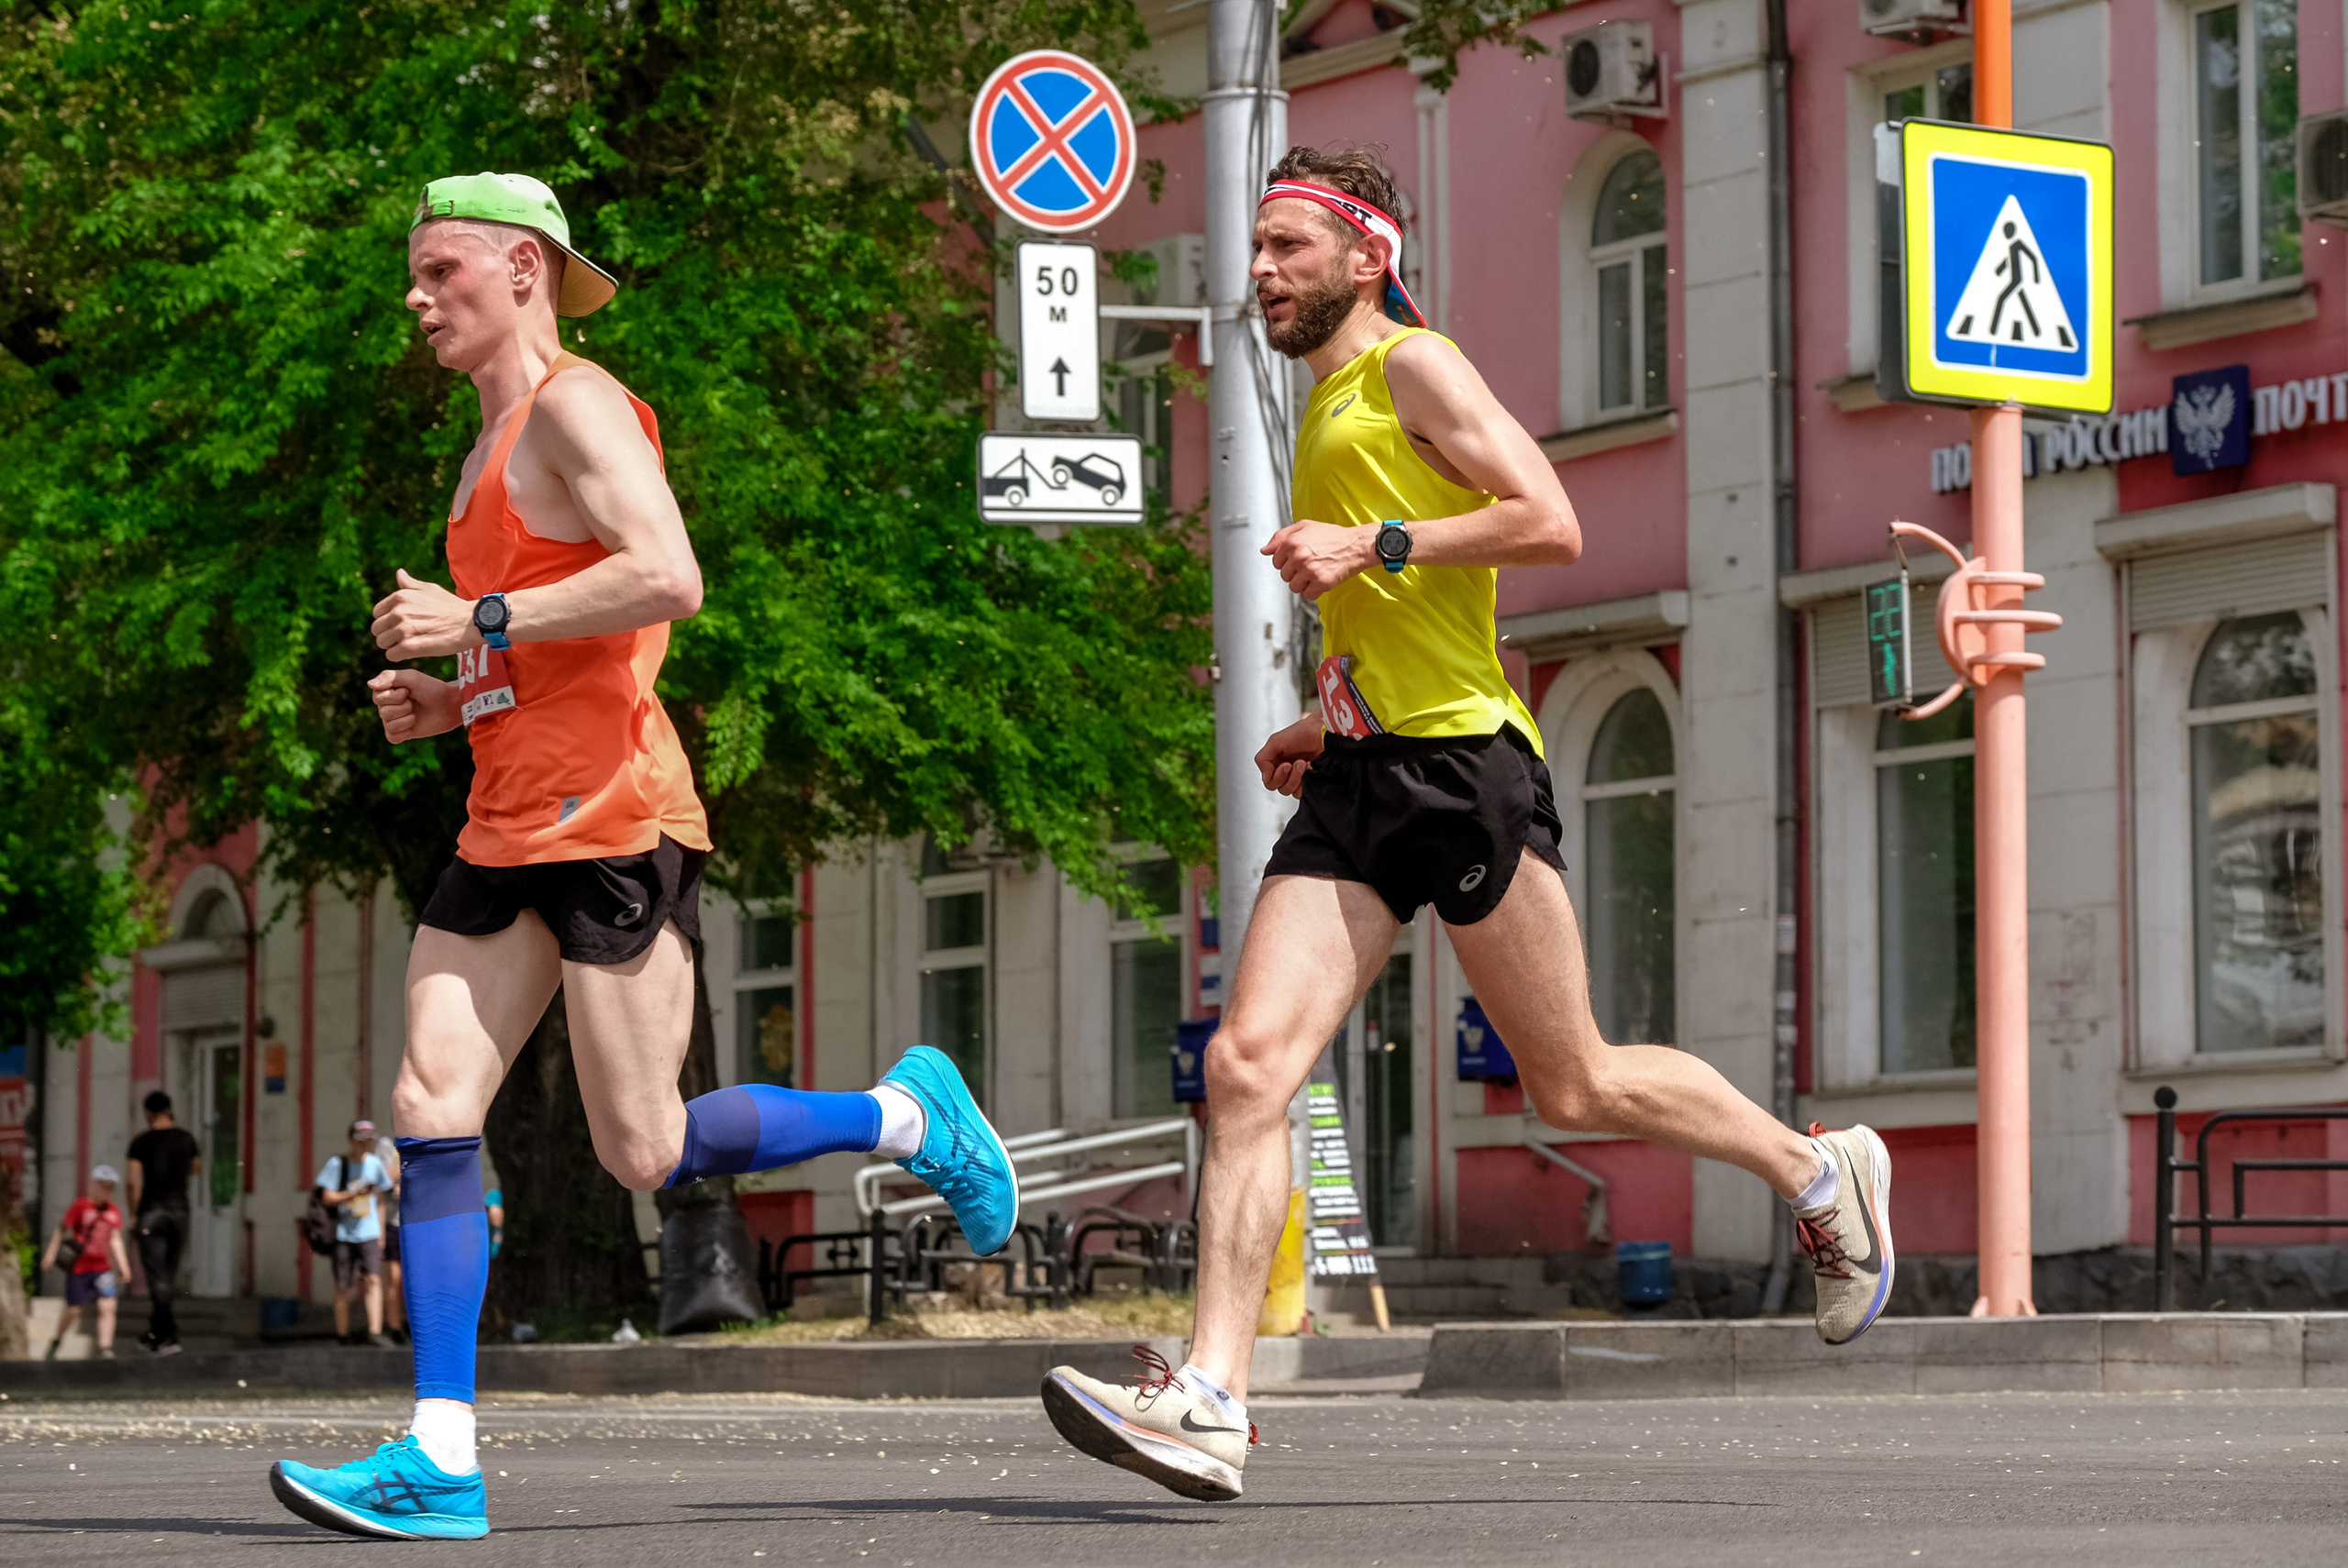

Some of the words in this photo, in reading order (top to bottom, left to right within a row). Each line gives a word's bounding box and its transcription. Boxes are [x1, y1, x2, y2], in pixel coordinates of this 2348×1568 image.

[1036, 266, 1078, 295] 50
[2044, 406, 2168, 470] РОССИИ
[1323, 666, 1364, 741] 13
